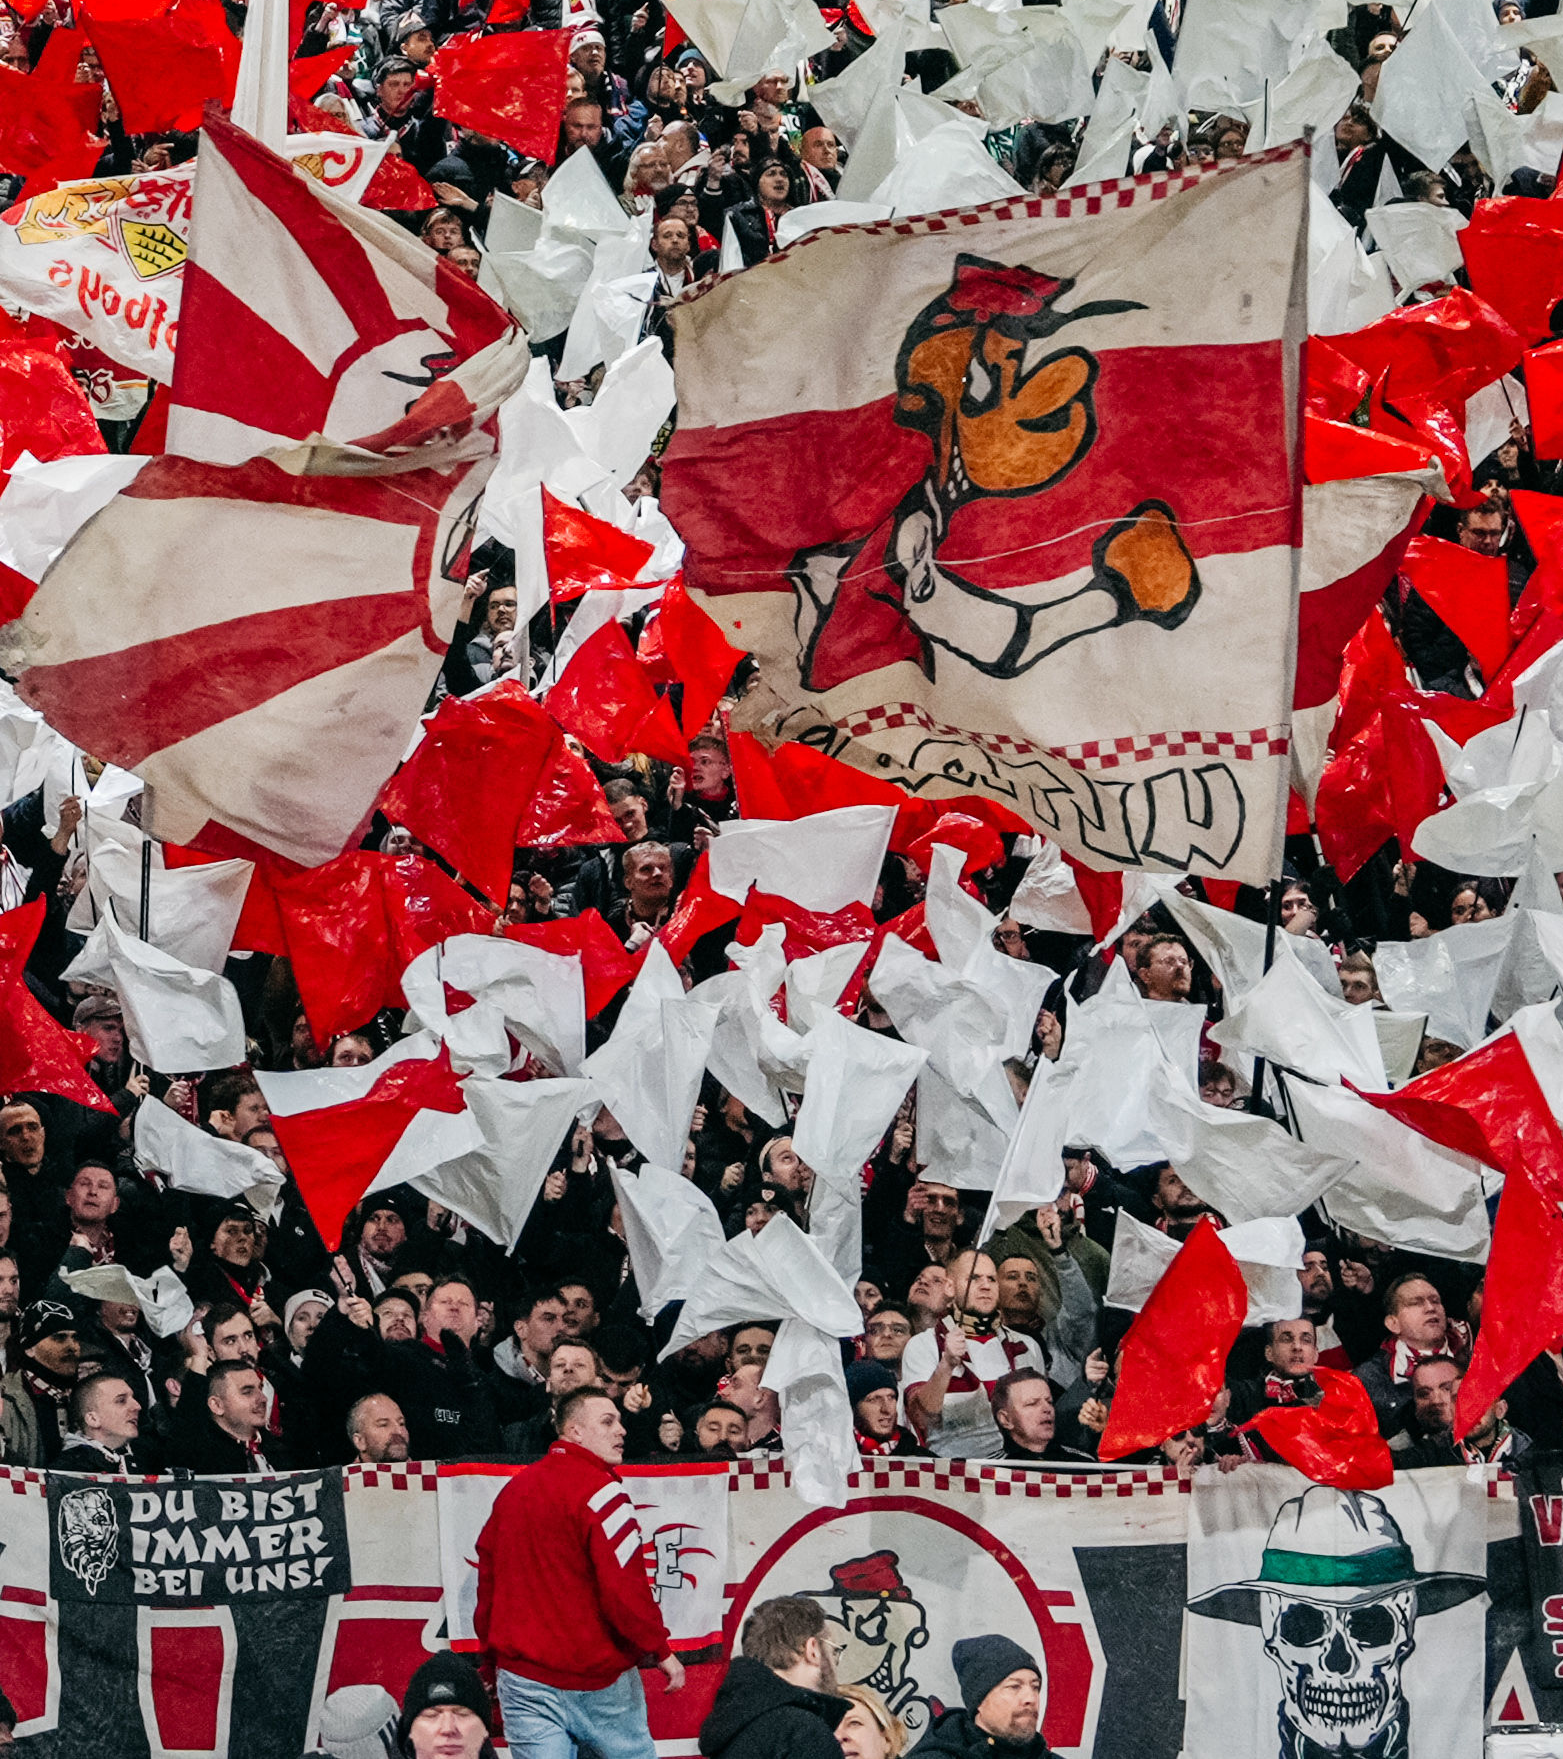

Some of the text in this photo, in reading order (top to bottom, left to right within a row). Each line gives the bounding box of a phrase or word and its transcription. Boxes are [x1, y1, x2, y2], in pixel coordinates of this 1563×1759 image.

[129, 1479, 326, 1524] DU BIST
[129, 1515, 331, 1563] IMMER
[131, 1555, 333, 1597] BEI UNS!
